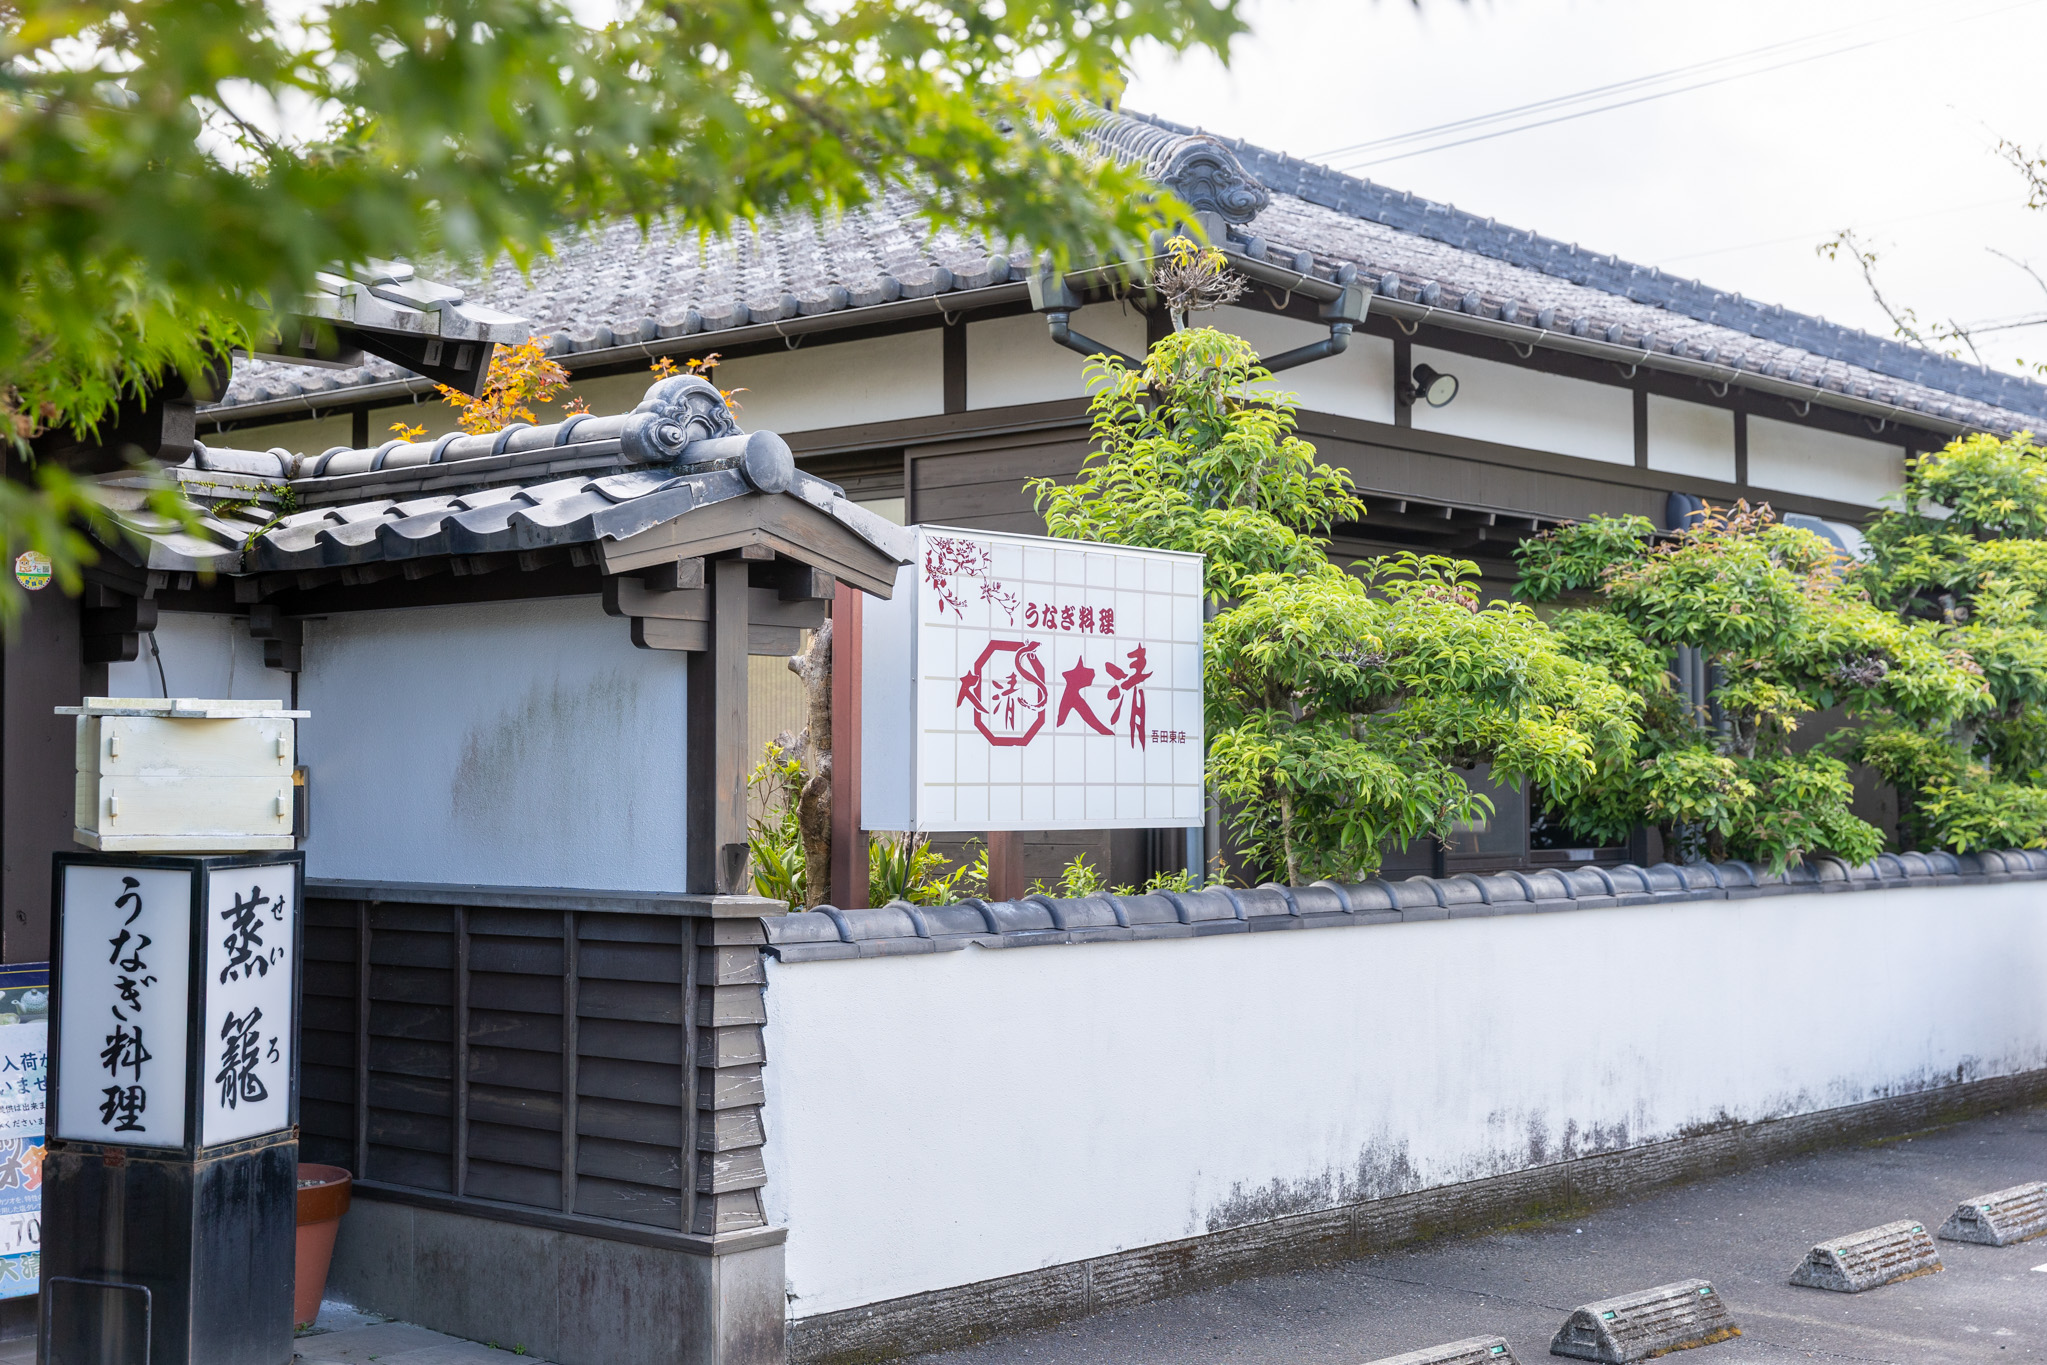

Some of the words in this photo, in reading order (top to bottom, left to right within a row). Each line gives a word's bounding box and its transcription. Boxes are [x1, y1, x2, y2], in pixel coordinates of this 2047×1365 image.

[1025, 602, 1114, 635] うなぎ料理
[1057, 642, 1153, 752] 大清
[1151, 729, 1186, 744] 吾田東店
[99, 877, 157, 1132] うなぎ料理
[215, 886, 270, 1110] 蒸籠
